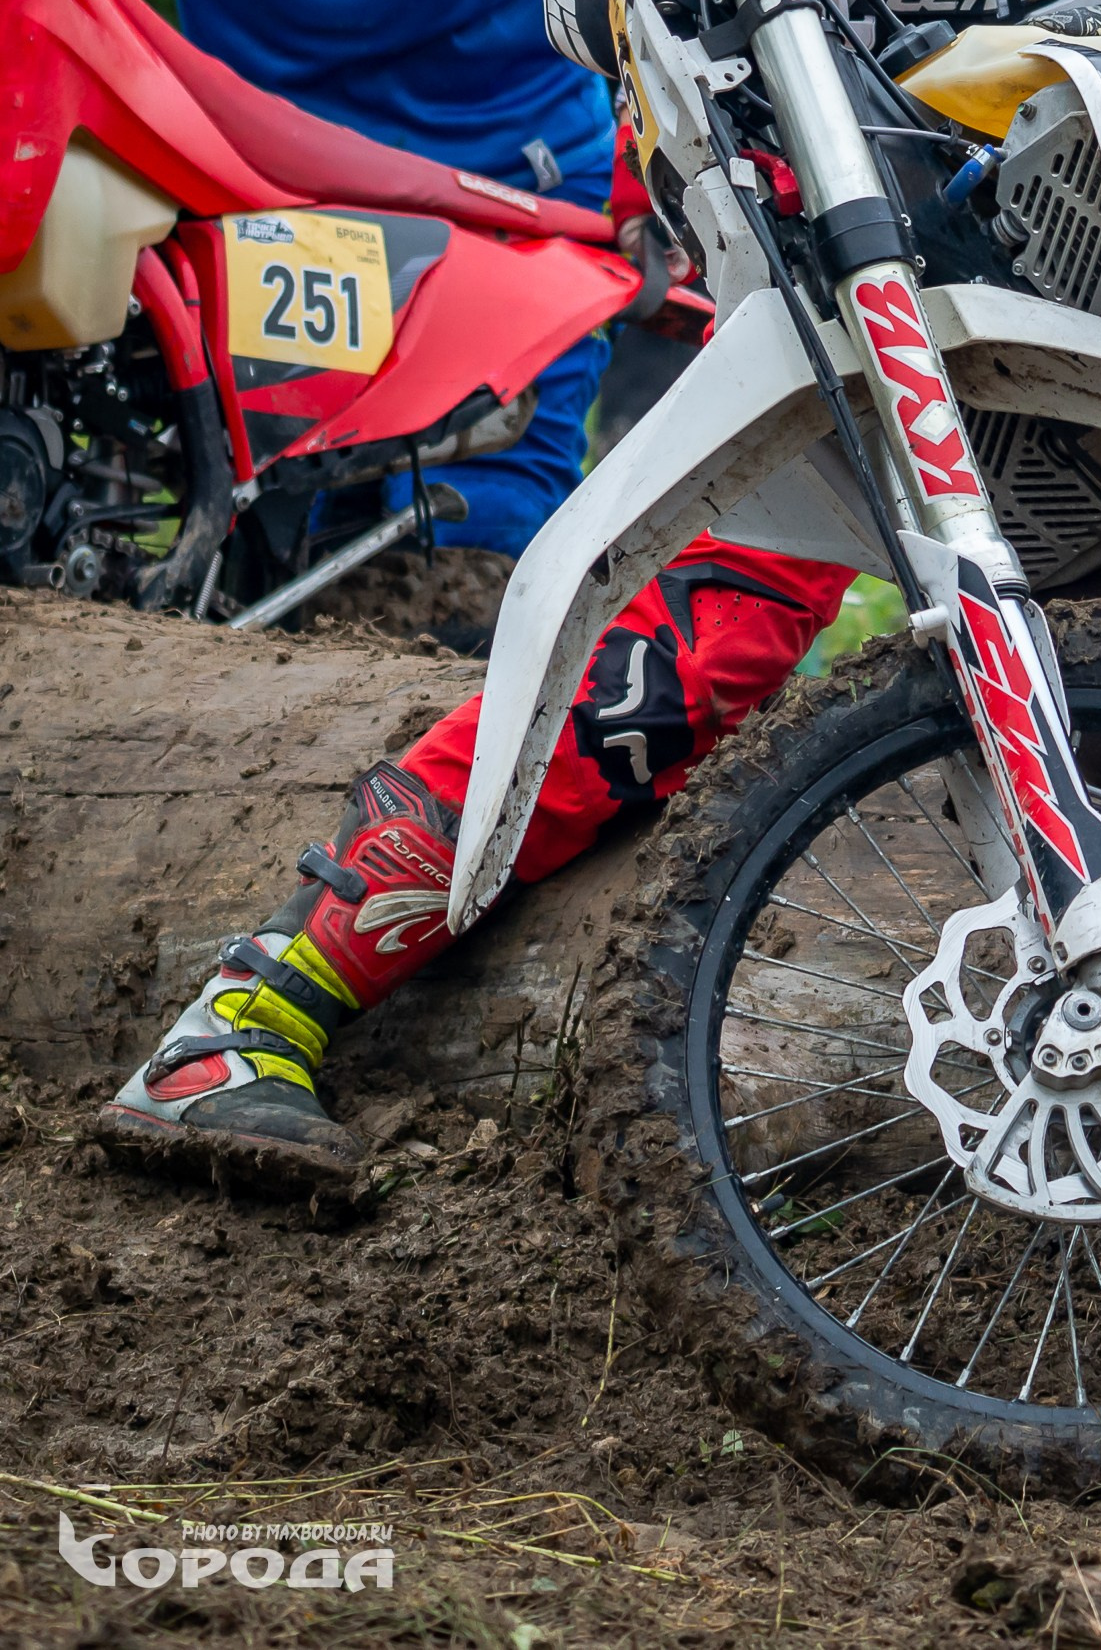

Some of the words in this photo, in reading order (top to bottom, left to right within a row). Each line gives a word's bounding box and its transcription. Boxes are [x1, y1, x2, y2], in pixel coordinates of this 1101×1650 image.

[459, 172, 538, 212] GASGAS
[336, 227, 377, 243] БРОНЗА
[263, 265, 360, 348] 251
[855, 280, 981, 497] KYB
[370, 776, 397, 813] BOULDER
